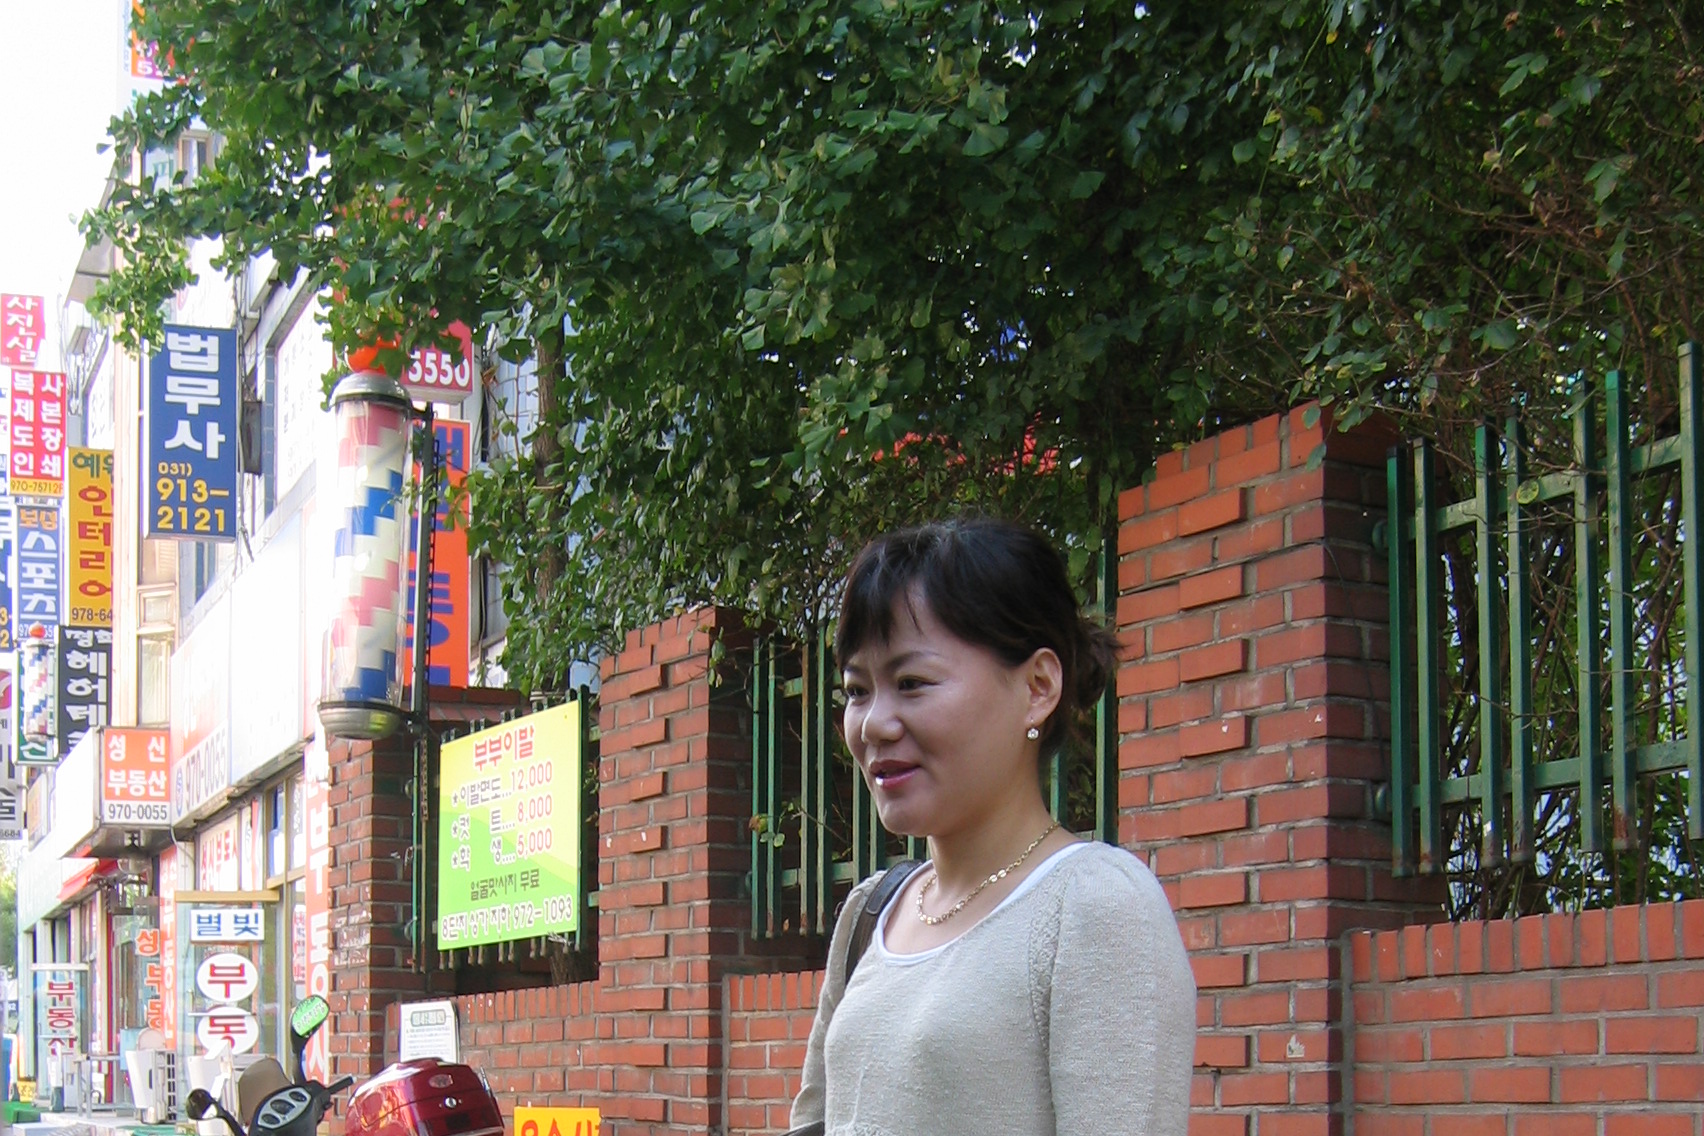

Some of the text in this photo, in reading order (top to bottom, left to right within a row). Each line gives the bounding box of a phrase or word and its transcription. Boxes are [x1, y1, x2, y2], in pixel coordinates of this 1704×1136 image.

[165, 332, 226, 459] 법무사
[158, 462, 192, 476] 031)
[156, 477, 229, 503] 913-
[157, 506, 225, 532] 2121
[20, 531, 57, 620] 스포츠
[475, 725, 534, 771] 부부이발
[108, 769, 167, 797] 부동산
[511, 761, 552, 791] 12,000
[108, 804, 167, 820] 970-0055
[517, 794, 552, 823] 8,000
[517, 828, 552, 856] 5,000
[520, 868, 540, 891] 무료
[513, 896, 572, 929] 972-1093
